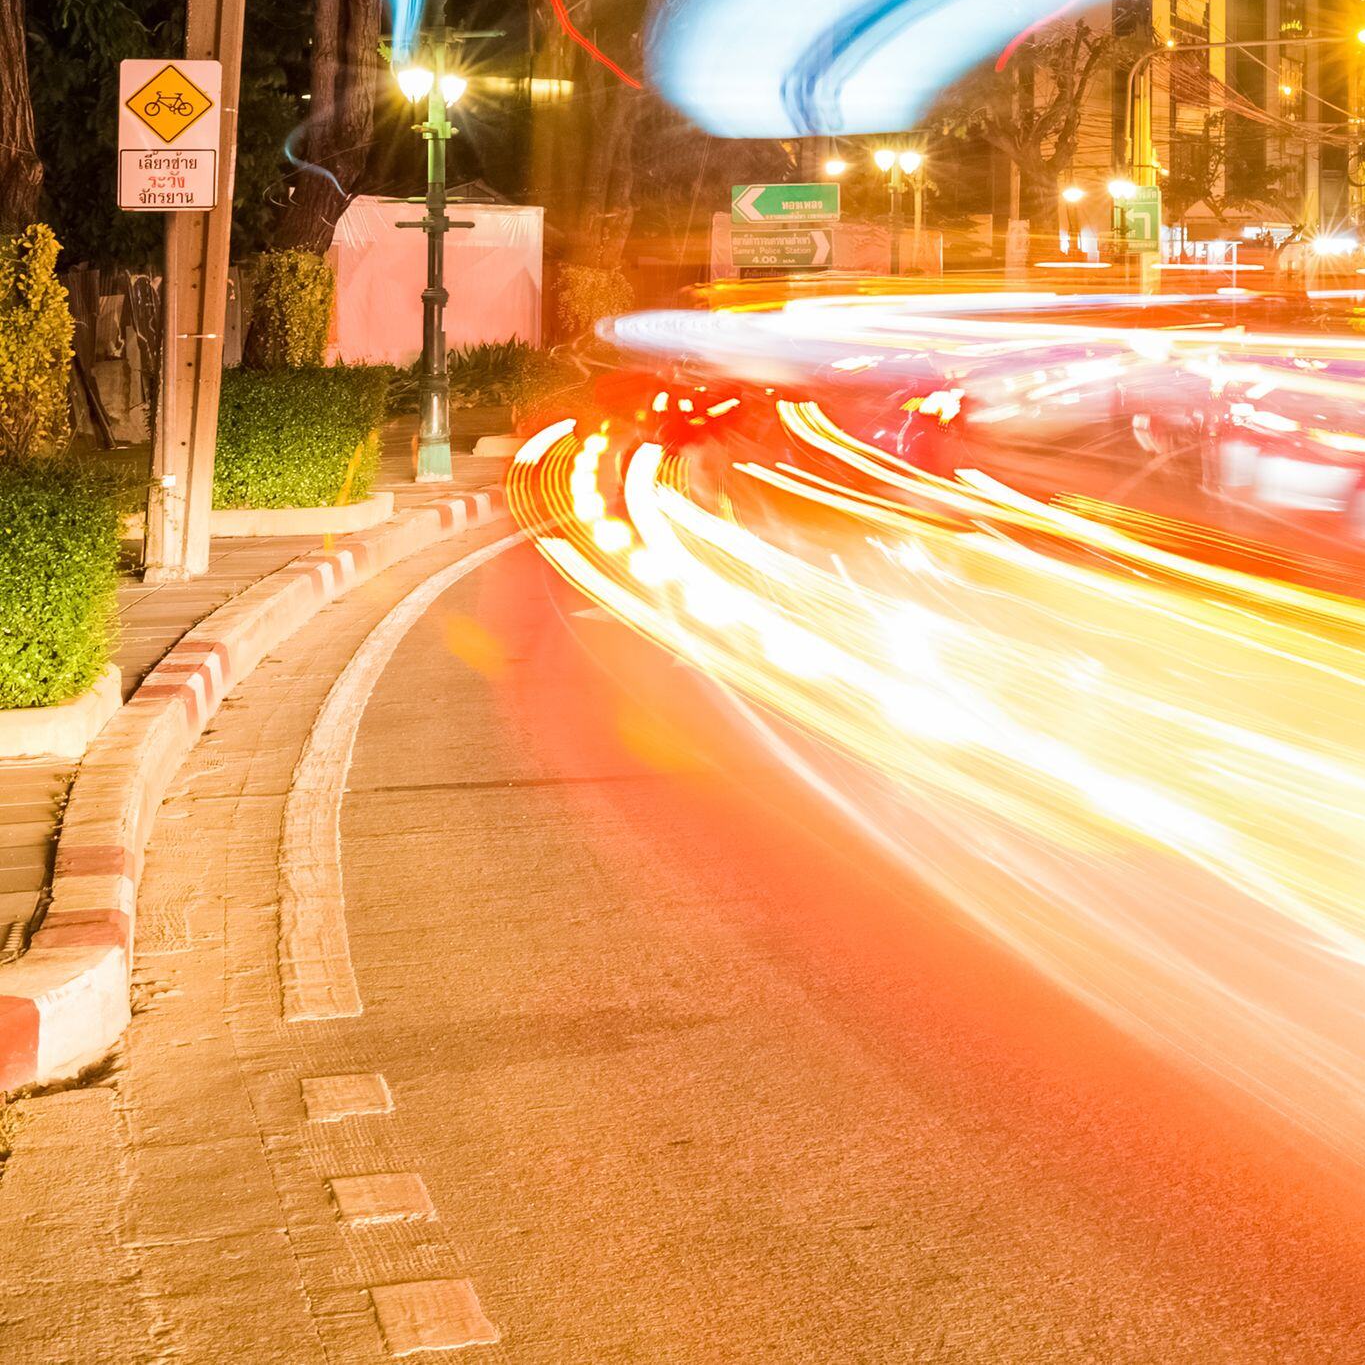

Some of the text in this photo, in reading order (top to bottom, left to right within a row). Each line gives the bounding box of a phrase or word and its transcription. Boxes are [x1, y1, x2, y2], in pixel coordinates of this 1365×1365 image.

[138, 150, 197, 170] เลี้ยวซ้าย
[148, 170, 185, 188] ระวัง
[139, 188, 195, 204] จักรยาน
[759, 246, 781, 255] Police
[785, 246, 811, 254] Station
[752, 255, 777, 264] 4.00
